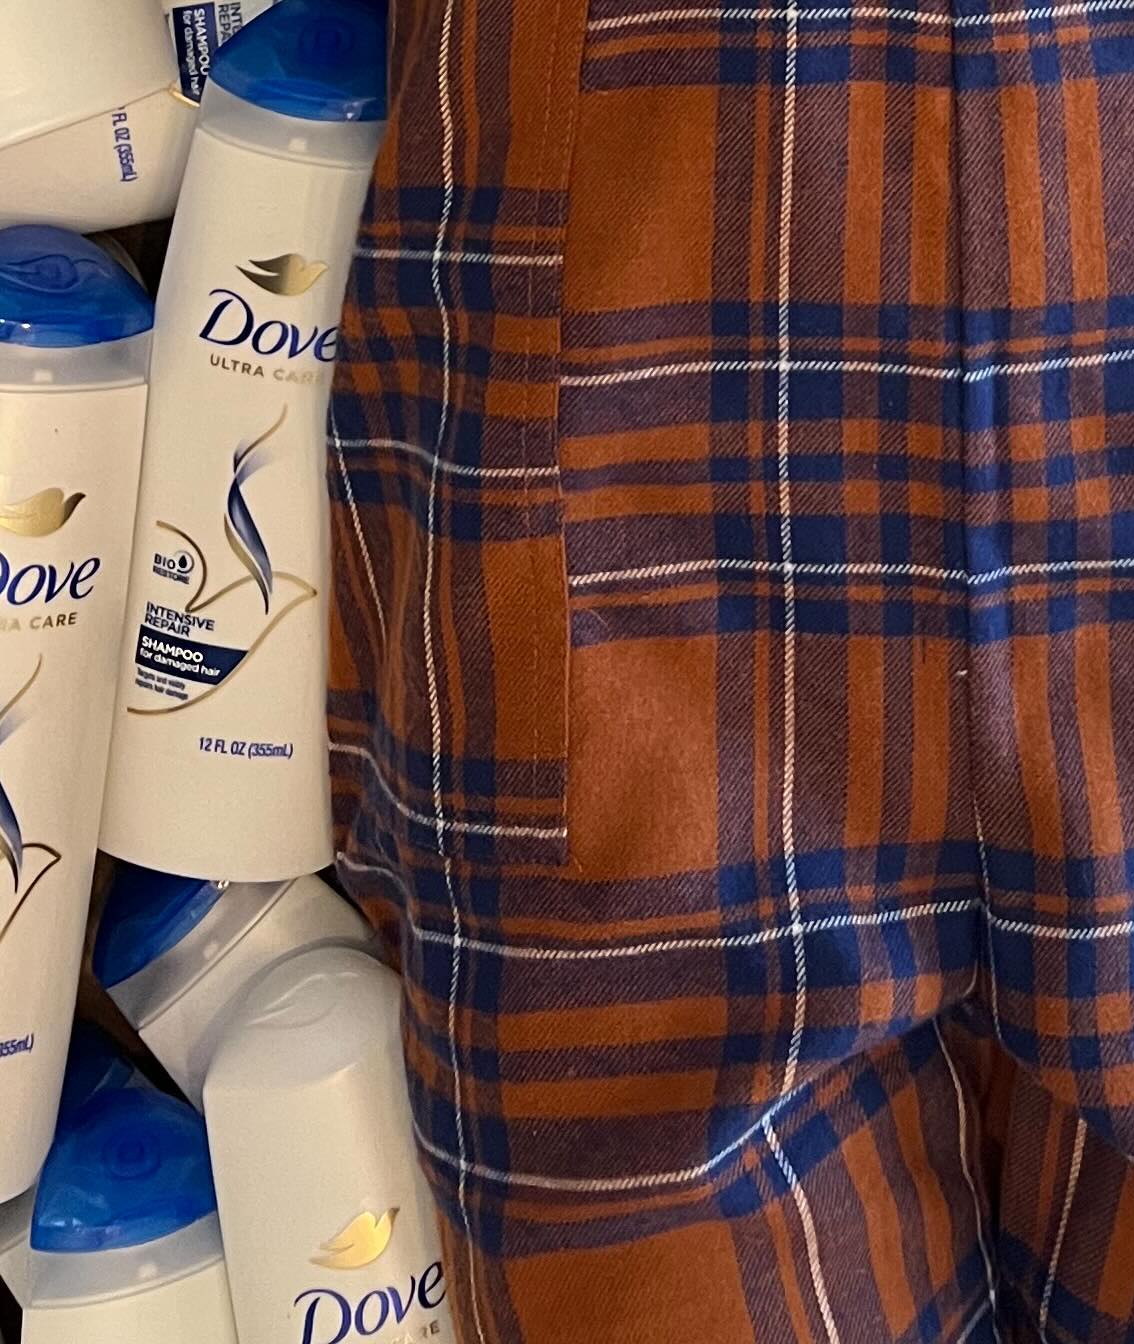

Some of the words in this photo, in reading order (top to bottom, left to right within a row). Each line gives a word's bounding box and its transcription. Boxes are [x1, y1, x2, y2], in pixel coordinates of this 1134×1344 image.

[112, 112, 128, 126] FL
[114, 127, 130, 142] OZ
[198, 288, 338, 363] Dove
[208, 353, 264, 378] ULTRA
[273, 368, 324, 386] CARE
[154, 553, 176, 570] BIO
[30, 612, 78, 630] CARE
[144, 614, 190, 638] REPAIR
[146, 600, 216, 632] INTENSIVE
[140, 646, 154, 661] for
[154, 652, 200, 674] damaged
[200, 664, 222, 678] hair
[142, 636, 204, 664] SHAMPOO
[200, 737, 212, 752] 12
[214, 738, 227, 754] FL
[230, 741, 246, 756] OZ
[248, 743, 294, 760] (355mL)
[294, 1261, 446, 1344] Dove
